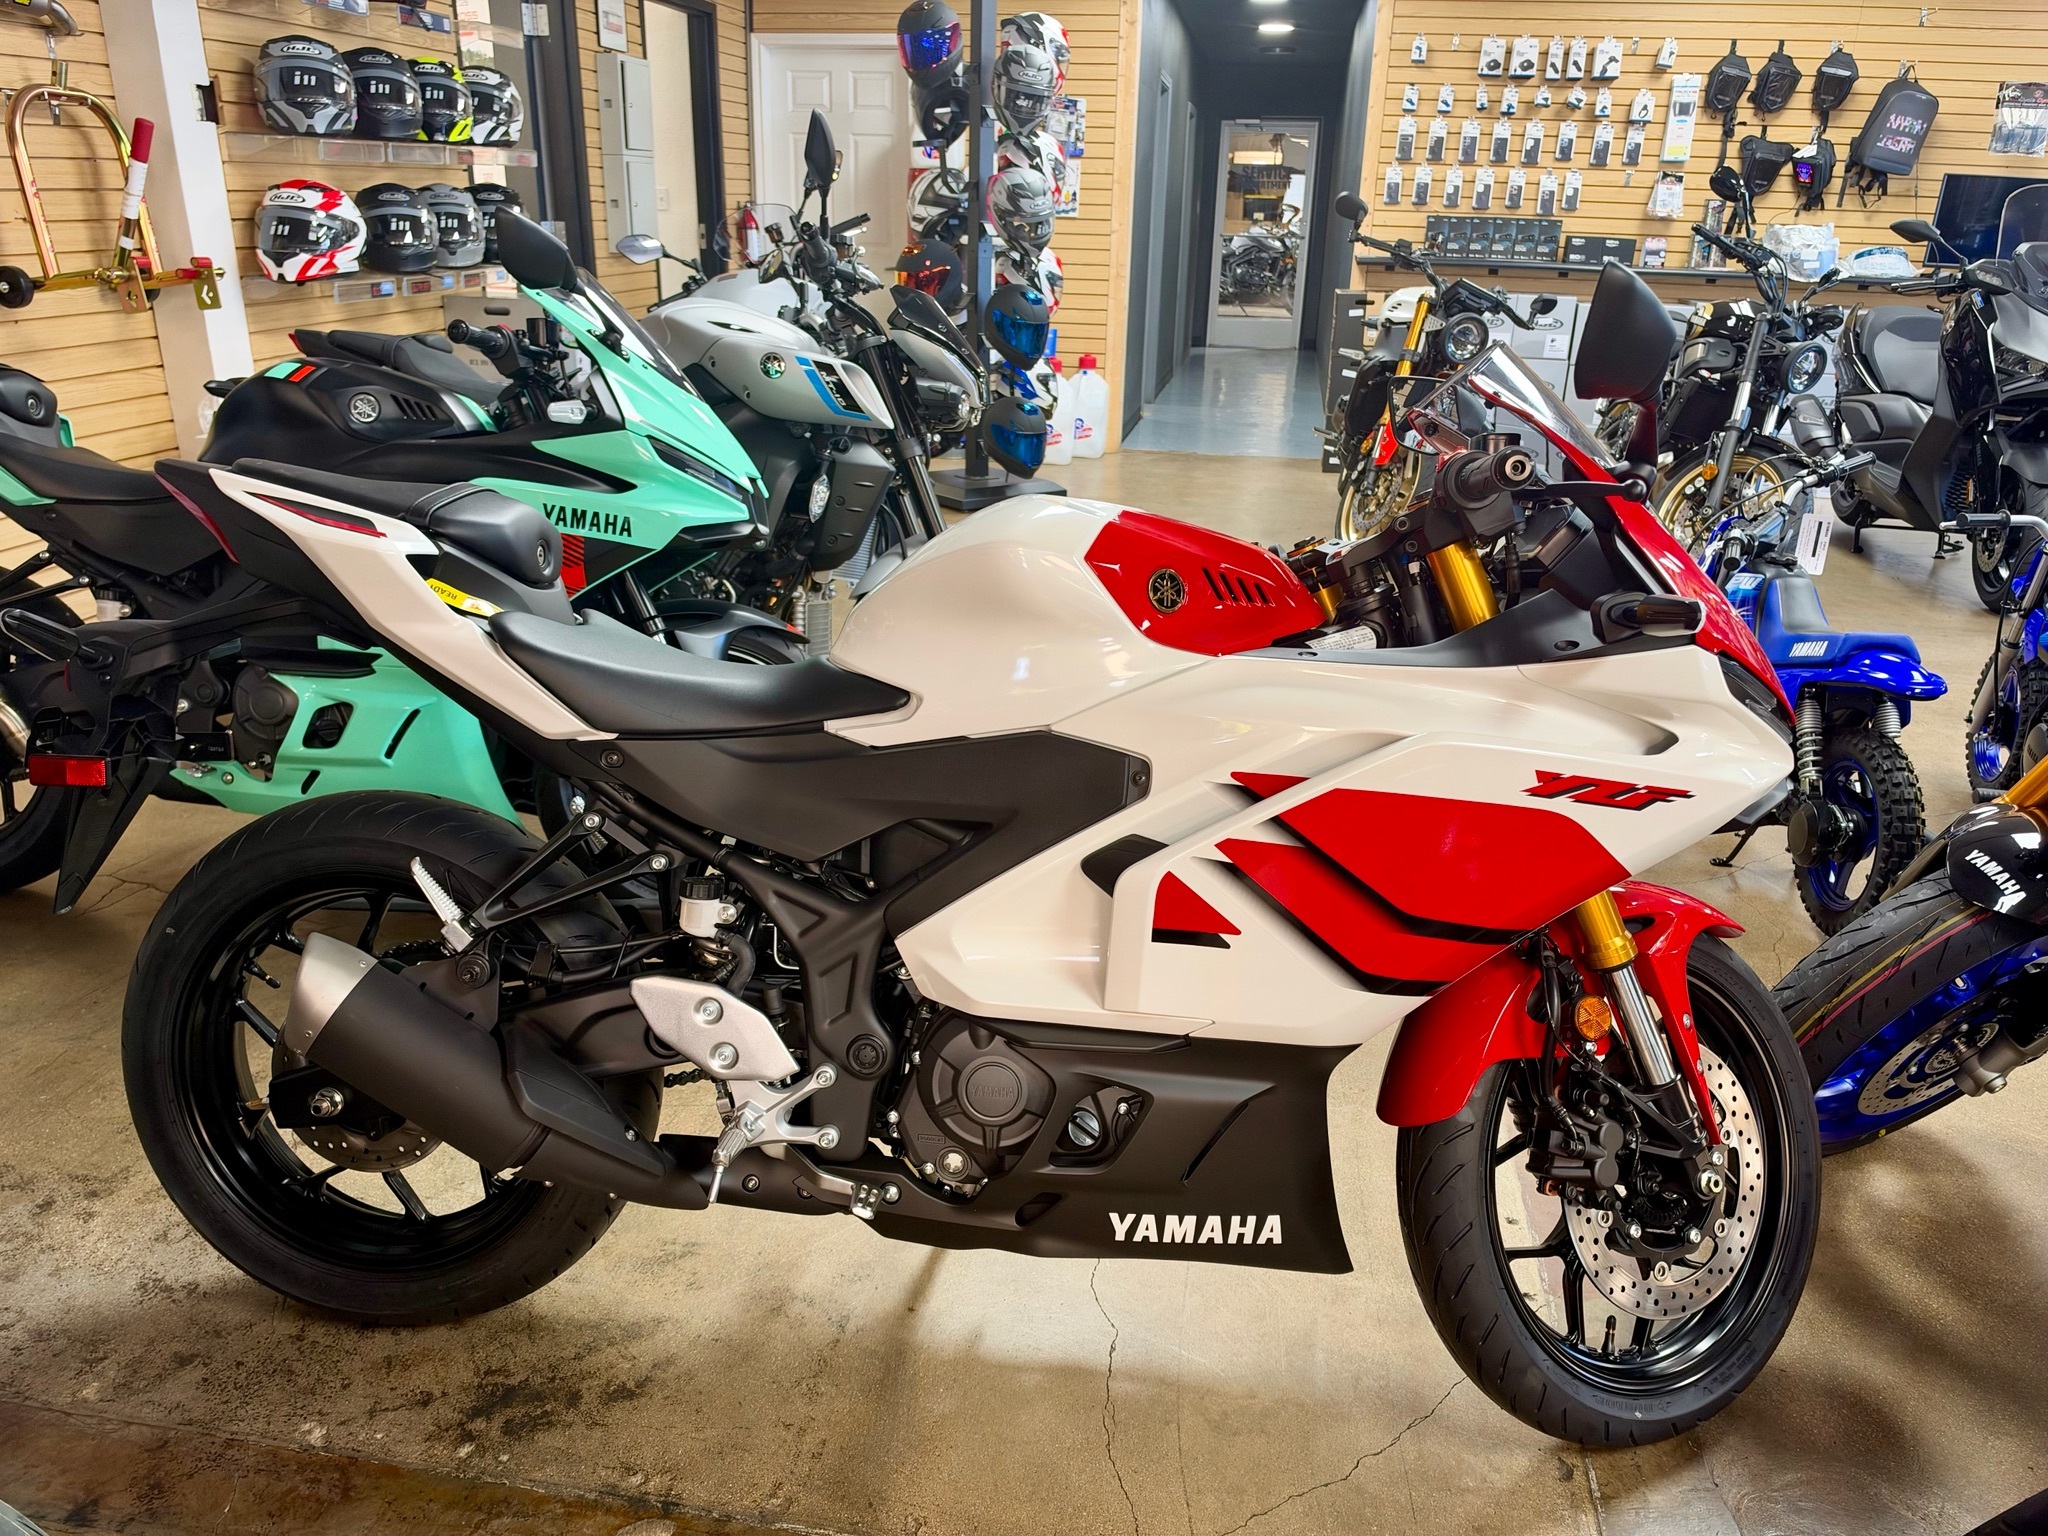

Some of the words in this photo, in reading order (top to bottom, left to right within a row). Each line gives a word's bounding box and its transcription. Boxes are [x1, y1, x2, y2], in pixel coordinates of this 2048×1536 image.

[819, 371, 847, 406] MT-10
[542, 502, 633, 538] YAMAHA
[1788, 640, 1829, 658] YAMAHA
[1964, 849, 2027, 914] YAMAHA
[971, 1085, 1015, 1099] YAMAHA
[1108, 1212, 1282, 1245] YAMAHA
